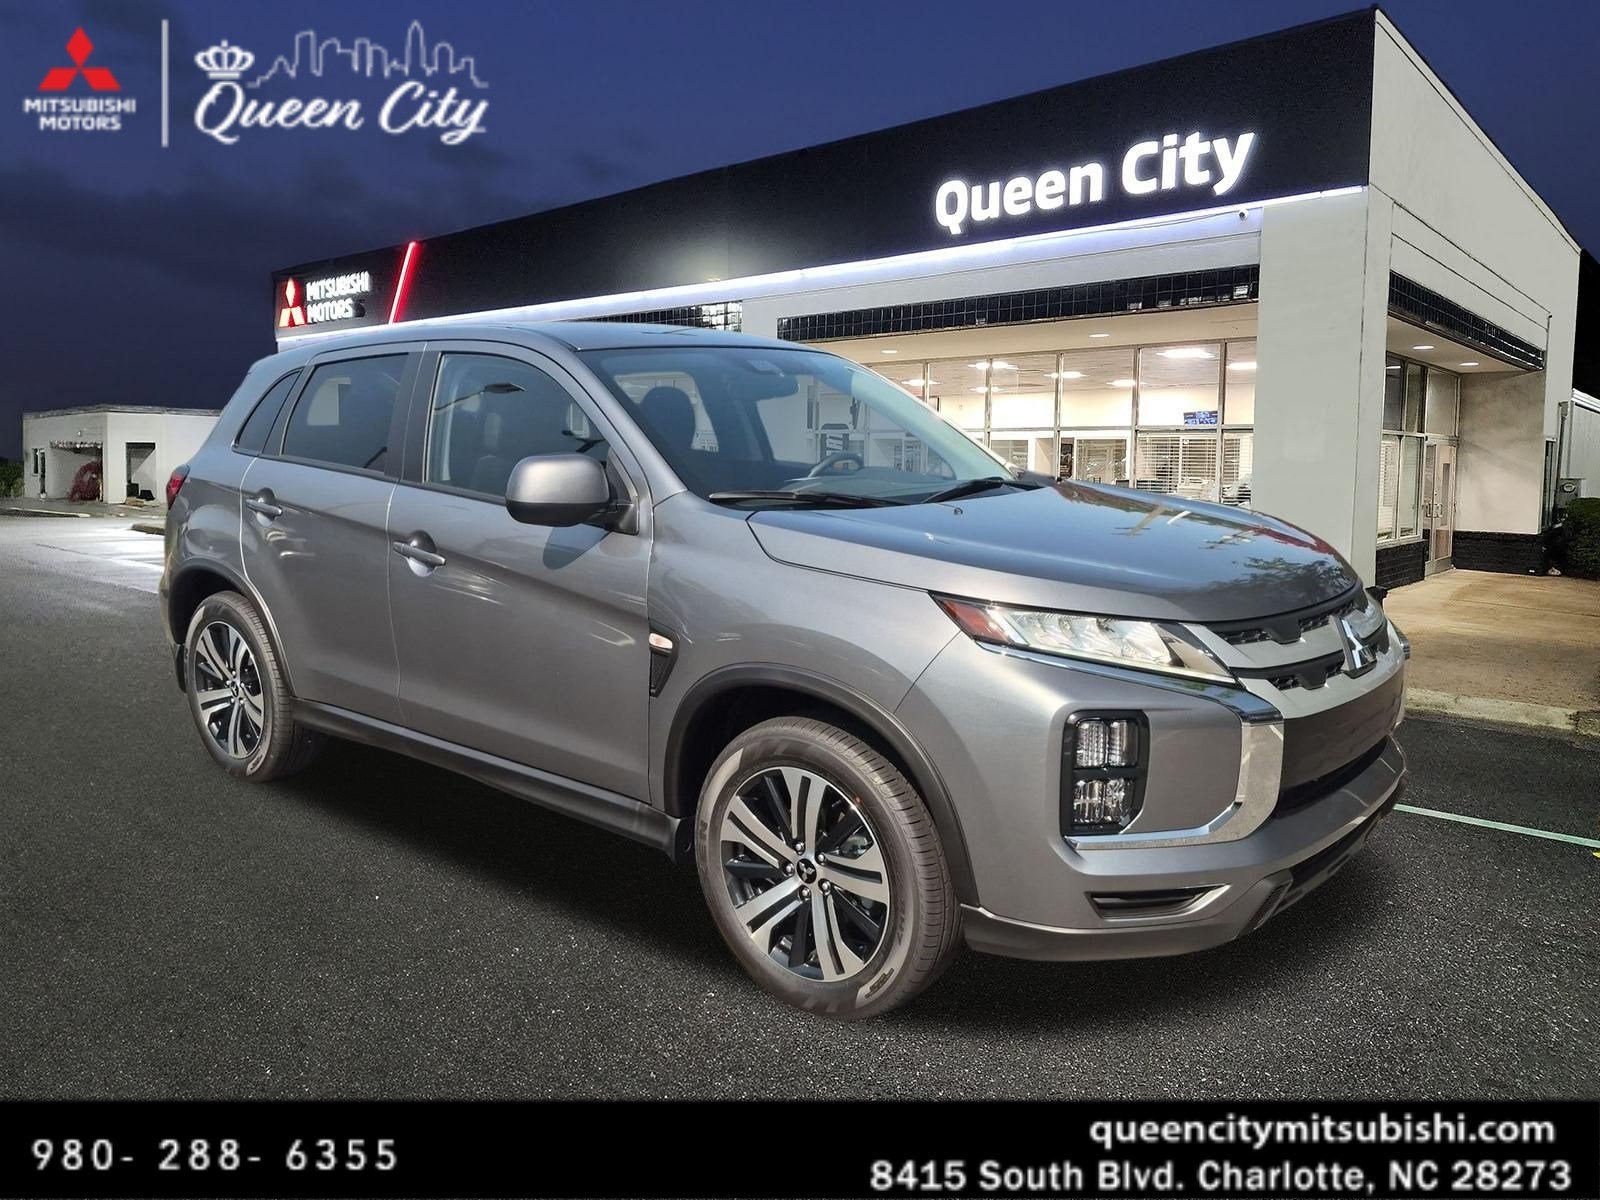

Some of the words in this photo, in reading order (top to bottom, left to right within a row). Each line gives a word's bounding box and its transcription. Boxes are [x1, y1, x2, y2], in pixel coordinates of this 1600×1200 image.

[935, 160, 1104, 235] Queen
[1121, 131, 1256, 197] City
[306, 270, 371, 302] MITSUBISHI
[306, 298, 354, 324] MOTORS
